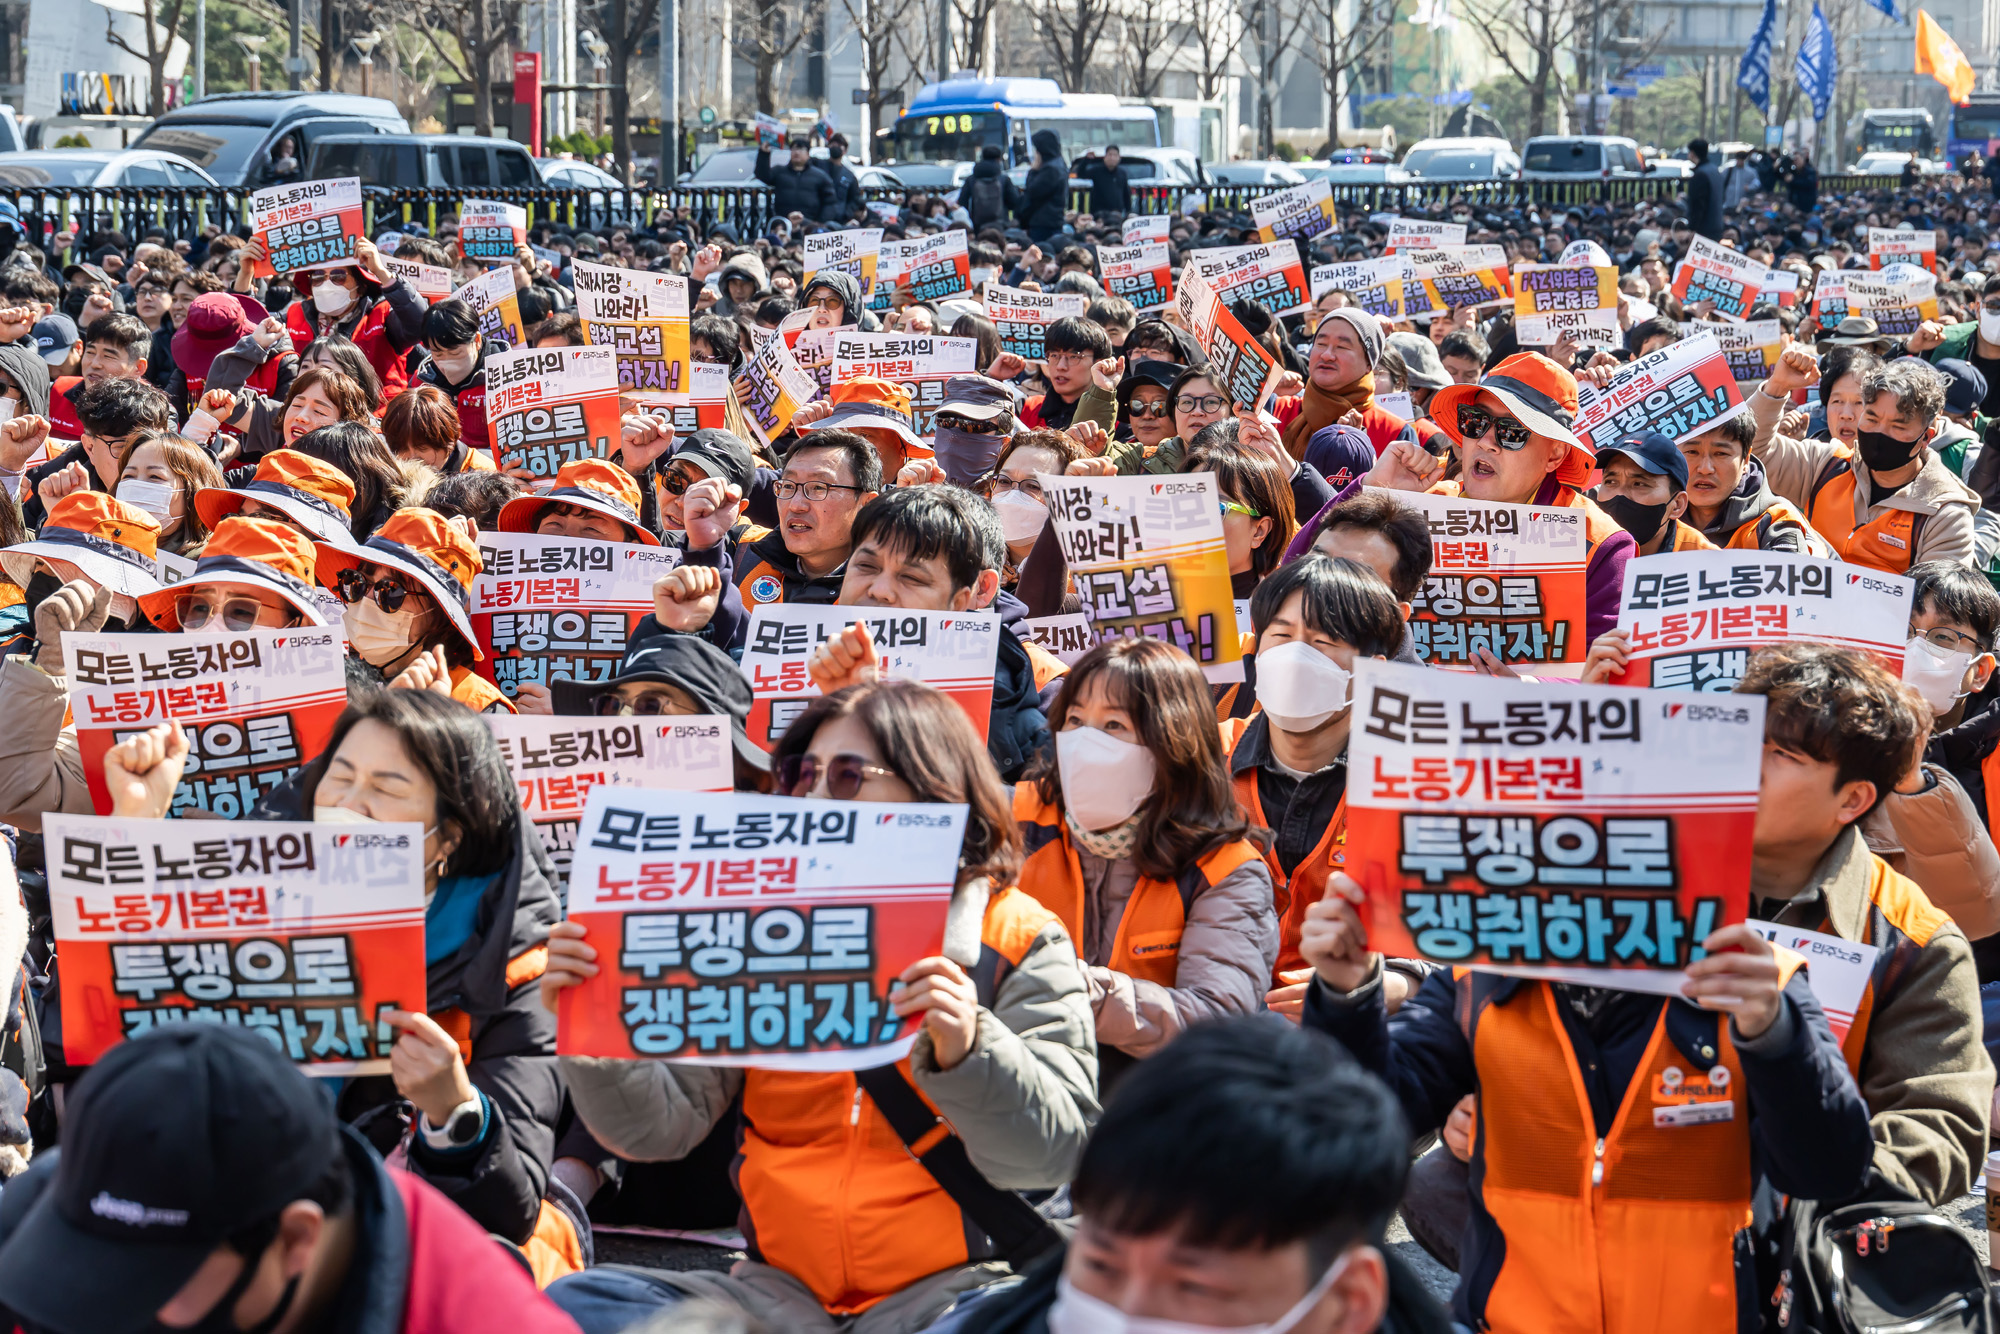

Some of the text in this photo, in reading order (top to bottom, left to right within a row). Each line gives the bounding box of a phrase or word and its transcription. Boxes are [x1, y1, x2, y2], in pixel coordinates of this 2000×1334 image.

[927, 114, 973, 135] 708
[256, 184, 326, 212] 모든 노동자의
[1254, 192, 1294, 213] 진짜사장
[1278, 196, 1312, 219] 나와라!
[258, 202, 312, 229] 노동기본권
[1271, 204, 1323, 236] 원청교섭
[1304, 214, 1332, 240] 하자!
[267, 214, 342, 250] 투쟁으로
[462, 228, 514, 241] 투쟁으로
[270, 235, 356, 272] 쟁취하자!
[464, 242, 514, 256] 쟁취하자
[806, 236, 844, 252] 진짜사장
[826, 244, 856, 264] 나와라!
[900, 246, 918, 258] 모든
[920, 236, 946, 252] 노동자의
[1695, 240, 1748, 268] 모든 노동자의
[904, 251, 938, 271] 노동기본권
[1202, 247, 1270, 278] 모든 노동자의
[1411, 252, 1448, 264] 진짜사장
[1436, 262, 1466, 274] 나와라!
[1692, 256, 1733, 275] 노동기본권
[386, 262, 420, 278] 동자의
[574, 266, 622, 294] 진짜사장
[909, 260, 957, 285] 투쟁으로
[1207, 266, 1260, 290] 노동기본권
[1314, 266, 1357, 282] 진짜사장
[1336, 272, 1376, 289] 나와라!
[1522, 268, 1599, 291] 쟁취하자!
[664, 279, 684, 288] 민주노총
[911, 274, 966, 302] 쟁취하자!
[1220, 272, 1288, 301] 투쟁으로
[1403, 280, 1427, 297] 교섭
[1433, 274, 1482, 291] 원청교섭
[1690, 272, 1744, 298] 투쟁으로
[1818, 286, 1844, 298] 노동기본
[1848, 282, 1887, 296] 진짜사장
[988, 290, 1053, 308] 모든 노동자의
[1123, 290, 1166, 310] 하자!
[1356, 285, 1386, 304] 교섭
[1536, 293, 1600, 311] 원청교섭
[1820, 298, 1848, 313] 투쟁
[478, 306, 502, 332] 교섭
[594, 295, 649, 321] 나와라!
[989, 306, 1040, 320] 노동기본권
[1363, 300, 1398, 317] 하자!
[996, 322, 1048, 340] 투쟁으
[1546, 313, 1587, 330] 나와라!
[1820, 314, 1846, 328] 쟁취
[837, 340, 865, 360] 모든
[869, 338, 934, 358] 노동자의
[1720, 334, 1754, 350] 와라!
[583, 350, 610, 360] 민주노총
[487, 351, 564, 391] 모든 노동자의
[619, 360, 680, 390] 하자!
[702, 366, 724, 374] 민주노총
[748, 358, 780, 404] 교섭
[808, 363, 832, 385] 교섭
[838, 360, 913, 382] 노동기본권
[1732, 364, 1774, 379] 하자!
[490, 381, 542, 418] 노동기본권
[901, 380, 944, 401] 으로
[1579, 388, 1594, 407] 든
[1574, 374, 1655, 434] 노동기본권
[1590, 373, 1702, 448] 투쟁으로
[1650, 387, 1726, 438] 하자!
[495, 403, 587, 450] 투쟁으로
[1166, 482, 1206, 495] 민주노총
[1048, 486, 1092, 523] 사장
[1424, 509, 1519, 536] 노동자의
[1542, 513, 1578, 524] 민주노총
[1061, 516, 1144, 564] 나와라!
[481, 545, 614, 576] 모든 노동자의
[638, 551, 673, 564] 민주노총
[480, 578, 580, 608] 노동기본권
[1628, 564, 1832, 610] 모든 노동자의
[1862, 577, 1904, 597] 민주노총
[318, 594, 343, 605] 주노총
[492, 612, 626, 652] 투쟁으로
[750, 617, 927, 655] 모든 자의
[954, 620, 992, 633] 민주노총
[1632, 604, 1788, 650] 노동기본권
[289, 634, 332, 648] 민주노총
[1033, 624, 1096, 656] 진짜
[76, 638, 262, 686] 모든 노동자의
[1651, 650, 1749, 694] 투쟁
[87, 682, 228, 723] 노동기본권
[1365, 686, 1640, 746] 모든 노동자의
[1686, 706, 1750, 724] 민주노총
[113, 711, 300, 776] 으로
[674, 726, 720, 738] 민주노총
[520, 724, 644, 770] 노동자의
[1372, 756, 1584, 802] 노동기본권
[518, 772, 606, 812] 기본권
[592, 806, 858, 852] 모든 노동자의
[898, 814, 952, 827] 민주노총
[354, 834, 410, 848] 민주노총
[1400, 814, 1675, 888] 투쟁으로
[62, 832, 316, 884] 모든 노동자의
[596, 856, 799, 902] 노동기본권
[75, 886, 270, 932] 노동기본권
[1403, 893, 1719, 965] 쟁취하자!
[621, 906, 872, 978] 투쟁으로
[1812, 941, 1864, 964] 민주노총
[110, 934, 357, 1001] 투쟁으로
[622, 979, 905, 1054] 쟁취하자!
[122, 1003, 397, 1059] 하자!
